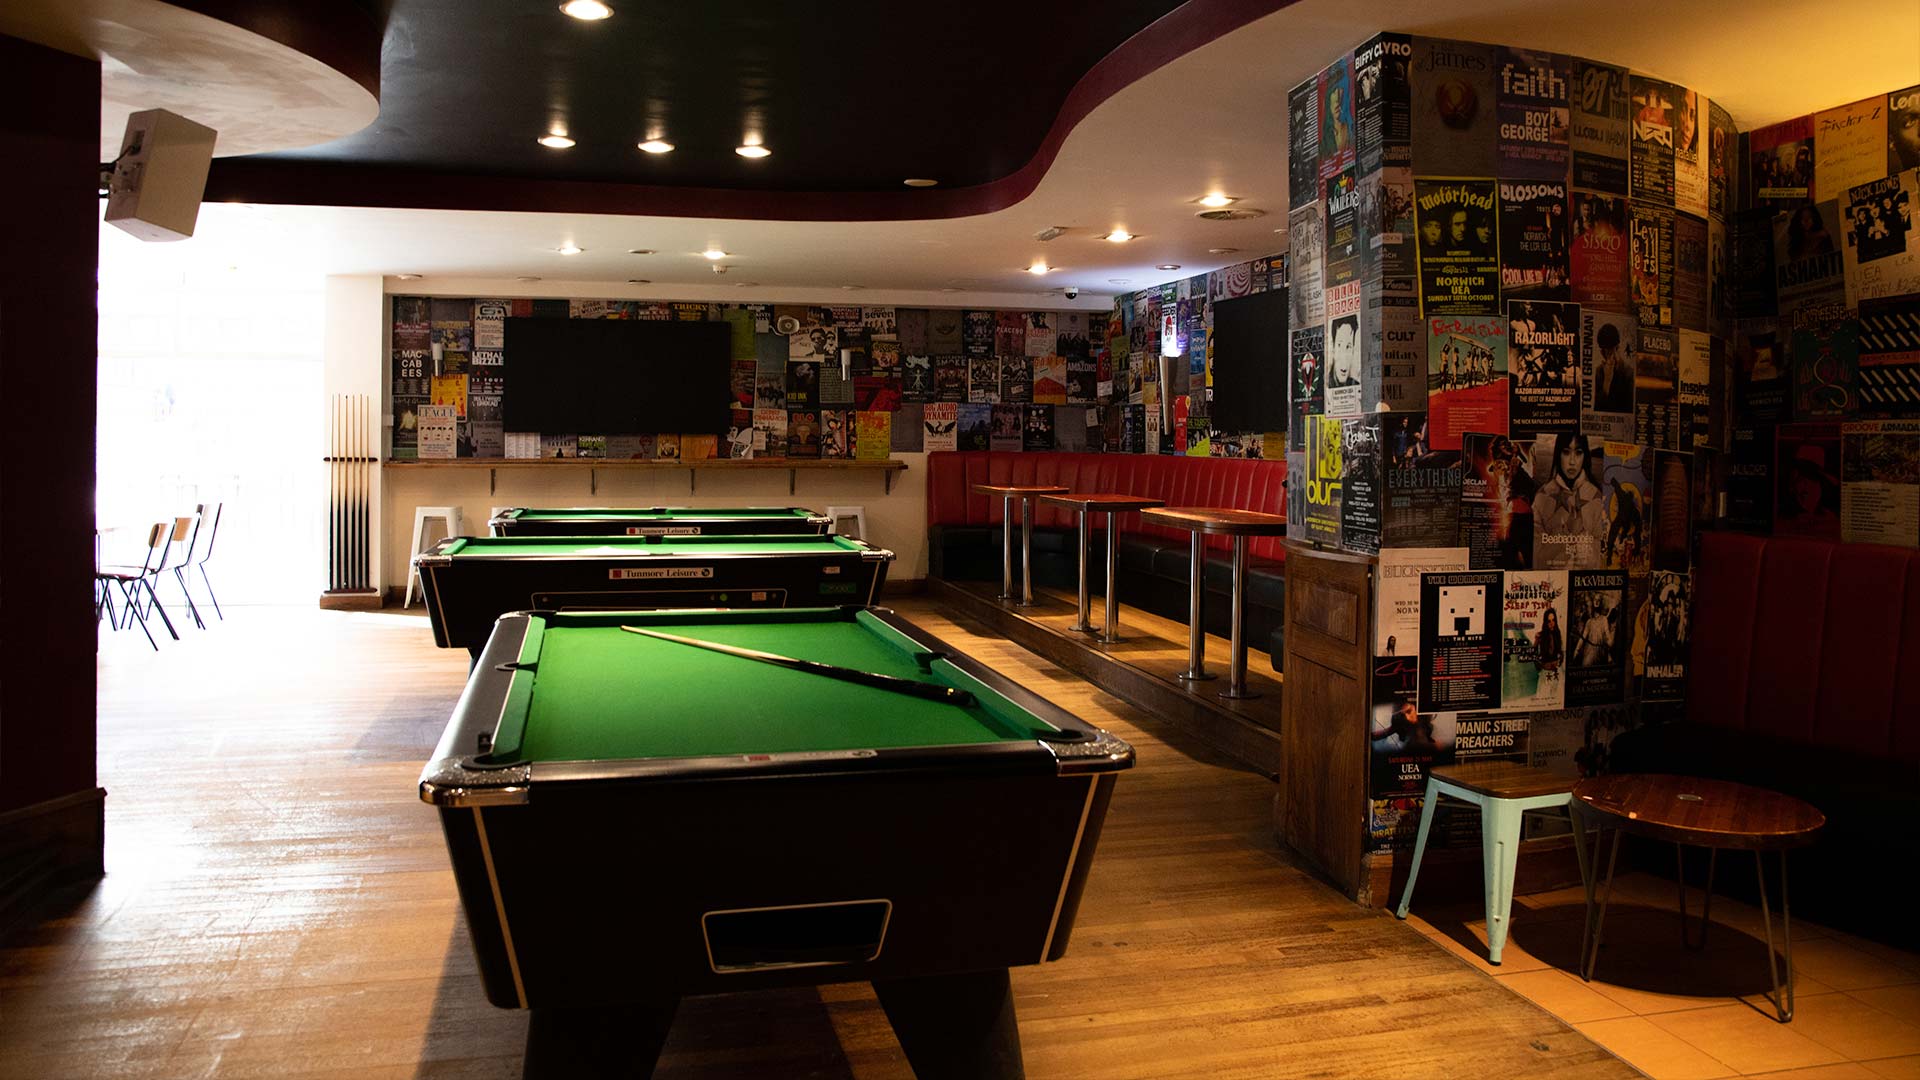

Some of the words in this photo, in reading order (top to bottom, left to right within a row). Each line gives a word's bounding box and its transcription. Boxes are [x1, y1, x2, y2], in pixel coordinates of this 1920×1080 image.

[1355, 49, 1374, 71] BIFFY
[1373, 43, 1412, 58] CLYRO
[1501, 63, 1566, 99] faith
[1525, 110, 1550, 127] BOY
[1501, 124, 1550, 143] GEORGE
[1501, 183, 1564, 202] BLOSSOMS
[1329, 186, 1360, 215] WAILERS
[1436, 276, 1485, 287] NORWICH
[1327, 280, 1361, 303] BILLY
[1451, 286, 1470, 295] UEA
[1327, 298, 1361, 317] BRAGG
[1387, 331, 1416, 342] CULT
[1514, 332, 1576, 345] RAZORLIGHT
[402, 350, 422, 358] MAC
[402, 359, 423, 368] CAB
[402, 369, 422, 378] EES
[1582, 380, 1593, 410] TOM
[936, 403, 957, 412] AUDIO
[1842, 423, 1880, 433] GROOVE
[1880, 423, 1920, 432] ARMADA
[1305, 414, 1343, 506] blur
[1388, 468, 1461, 481] EVERYTHING
[1388, 479, 1461, 489] EVERYTHING
[624, 569, 664, 577] Tunmore
[666, 569, 698, 577] Leisure
[1427, 575, 1446, 584] THE
[1448, 575, 1498, 584] WOMBATS
[1646, 664, 1684, 678] INHALER
[1456, 720, 1492, 735] MANIC
[1493, 718, 1530, 733] STREET
[1456, 734, 1514, 750] PREACHERS
[1401, 763, 1420, 774] UEA
